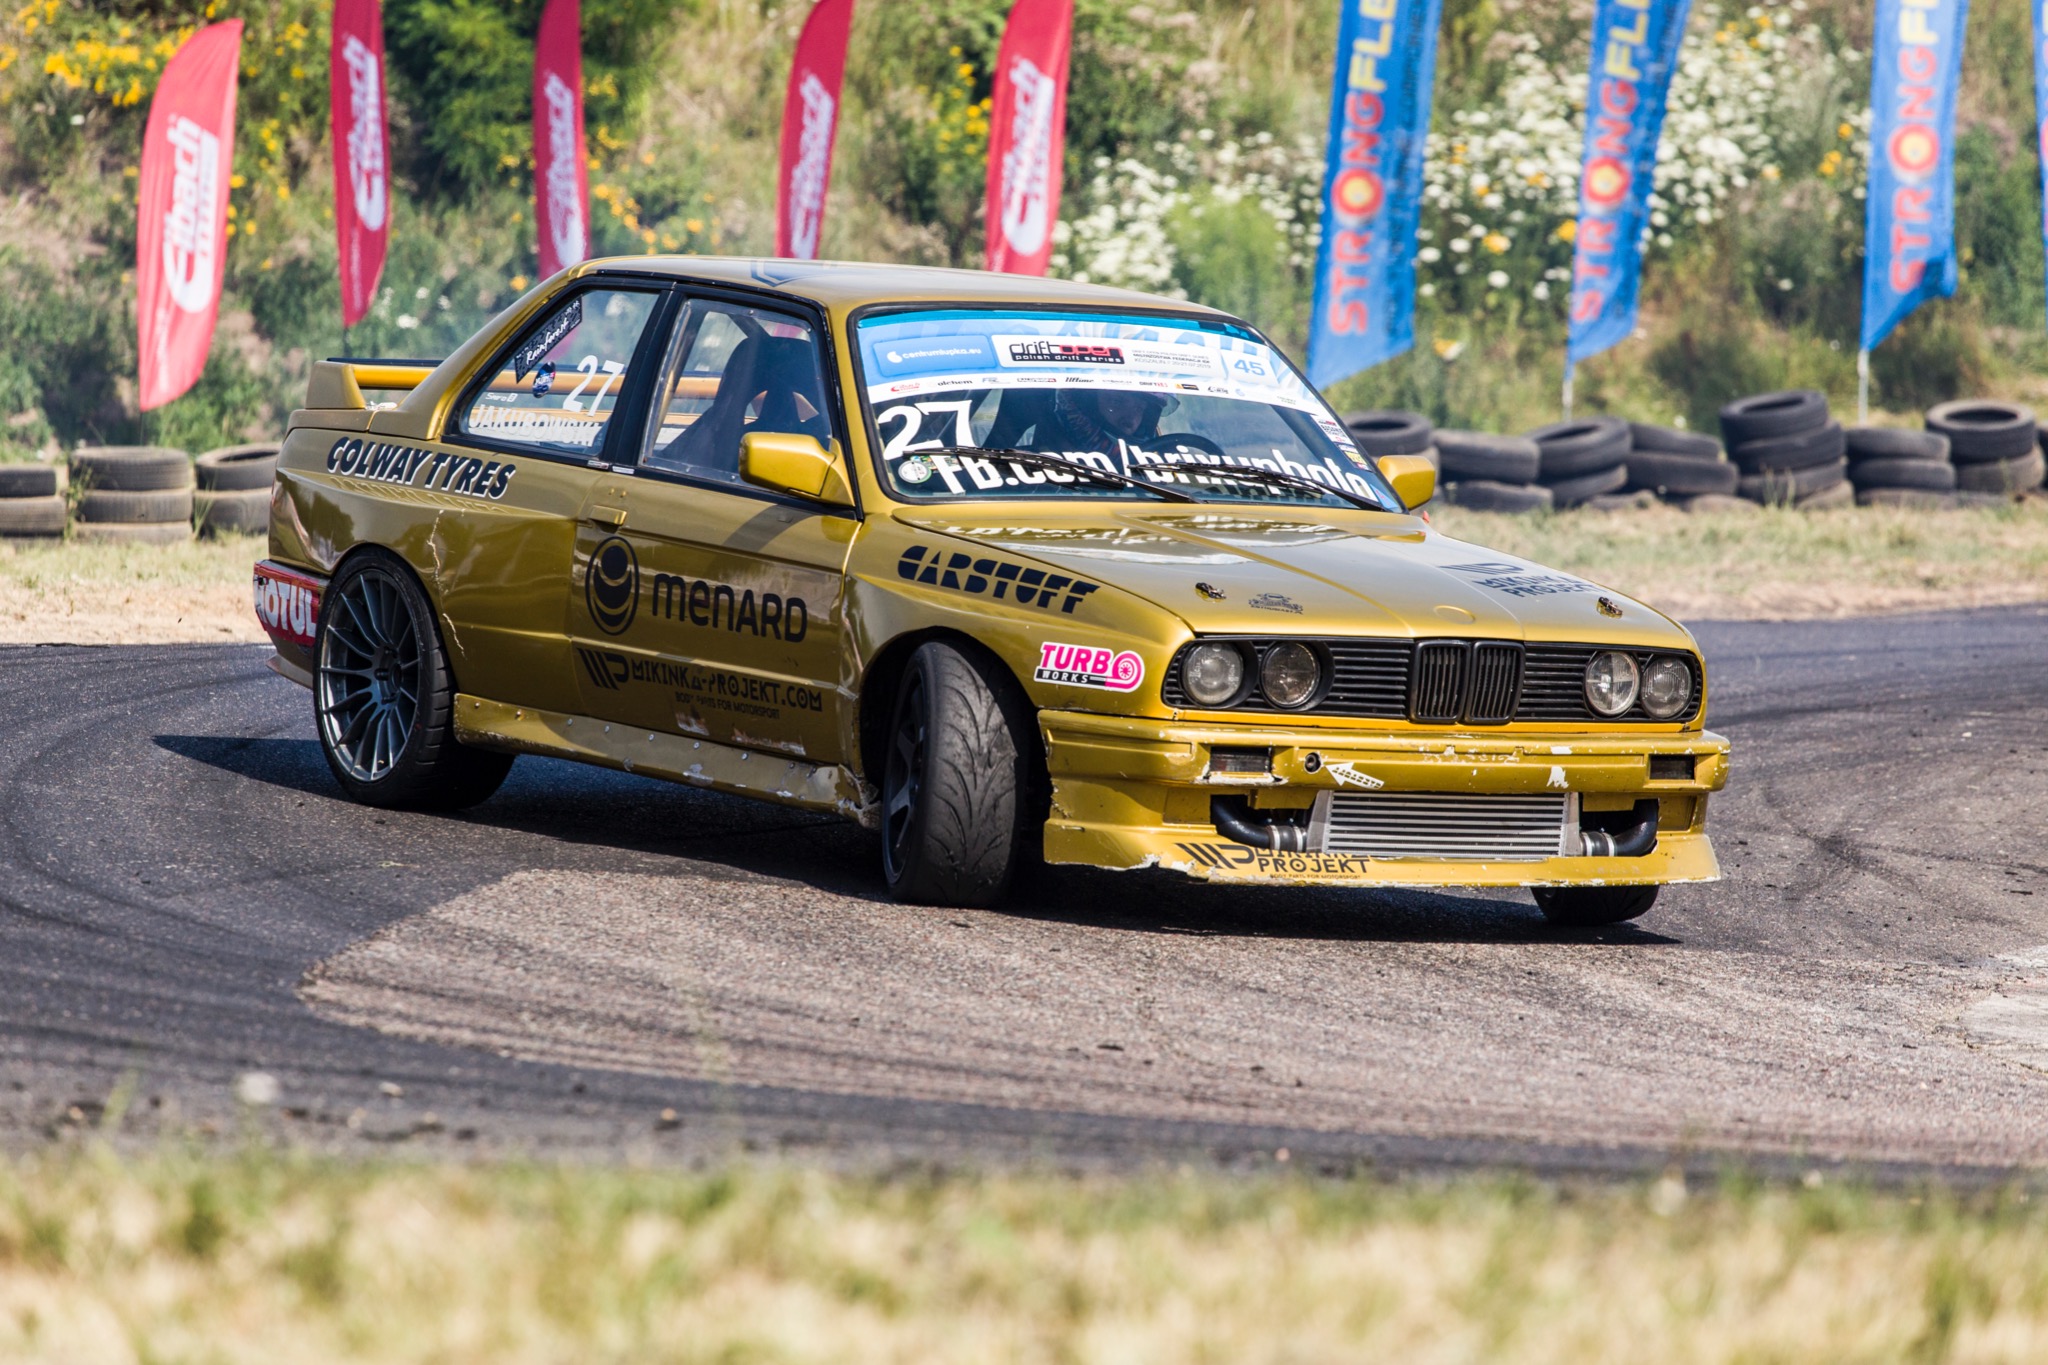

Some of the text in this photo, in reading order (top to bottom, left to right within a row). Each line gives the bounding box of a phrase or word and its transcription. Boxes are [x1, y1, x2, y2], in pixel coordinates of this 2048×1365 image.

[563, 355, 625, 417] 27
[1234, 359, 1265, 377] 45
[878, 400, 977, 460] 27
[327, 436, 517, 500] COLWAY TYRES
[897, 545, 1100, 614] CARSTUFF
[1042, 670, 1088, 683] WORKS
[1257, 857, 1370, 873] PROJEKT
